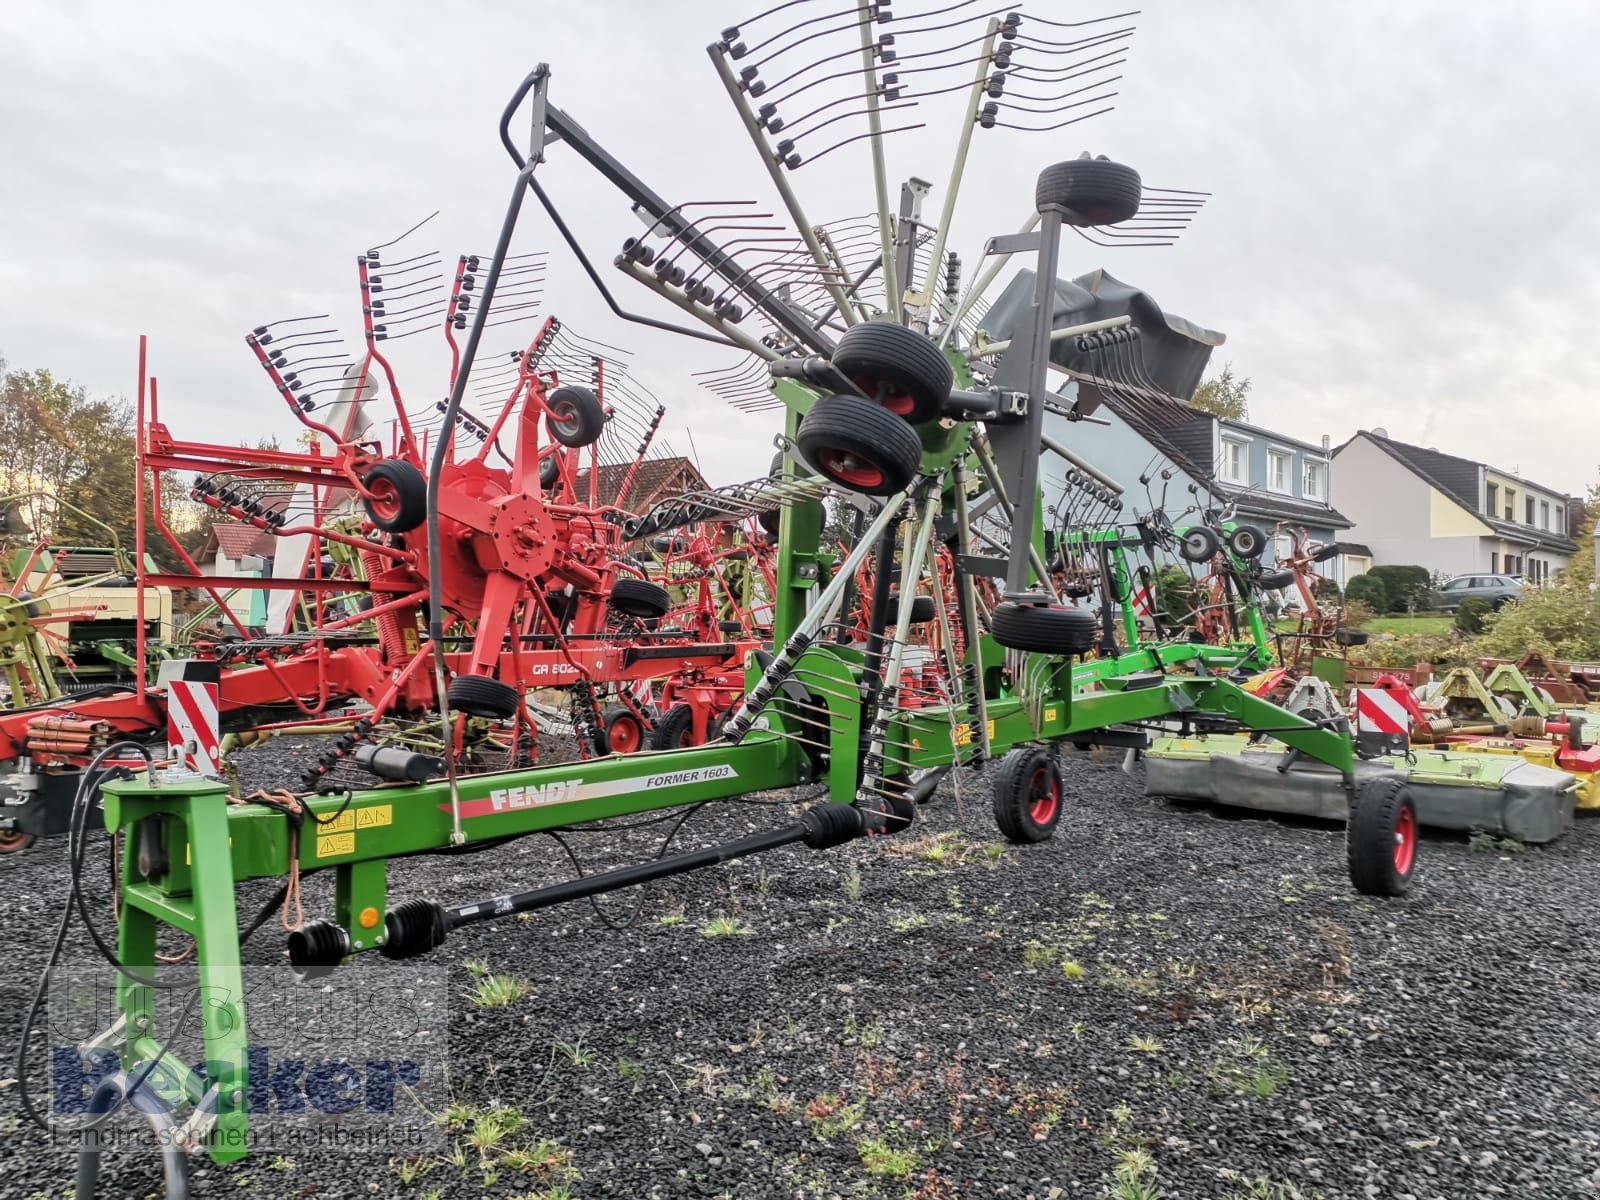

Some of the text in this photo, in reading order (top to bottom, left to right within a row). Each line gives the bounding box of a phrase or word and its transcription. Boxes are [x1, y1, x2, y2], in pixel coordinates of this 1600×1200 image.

[533, 664, 549, 675] GA
[646, 766, 730, 788] FORMER 1603
[489, 779, 583, 810] FENDT
